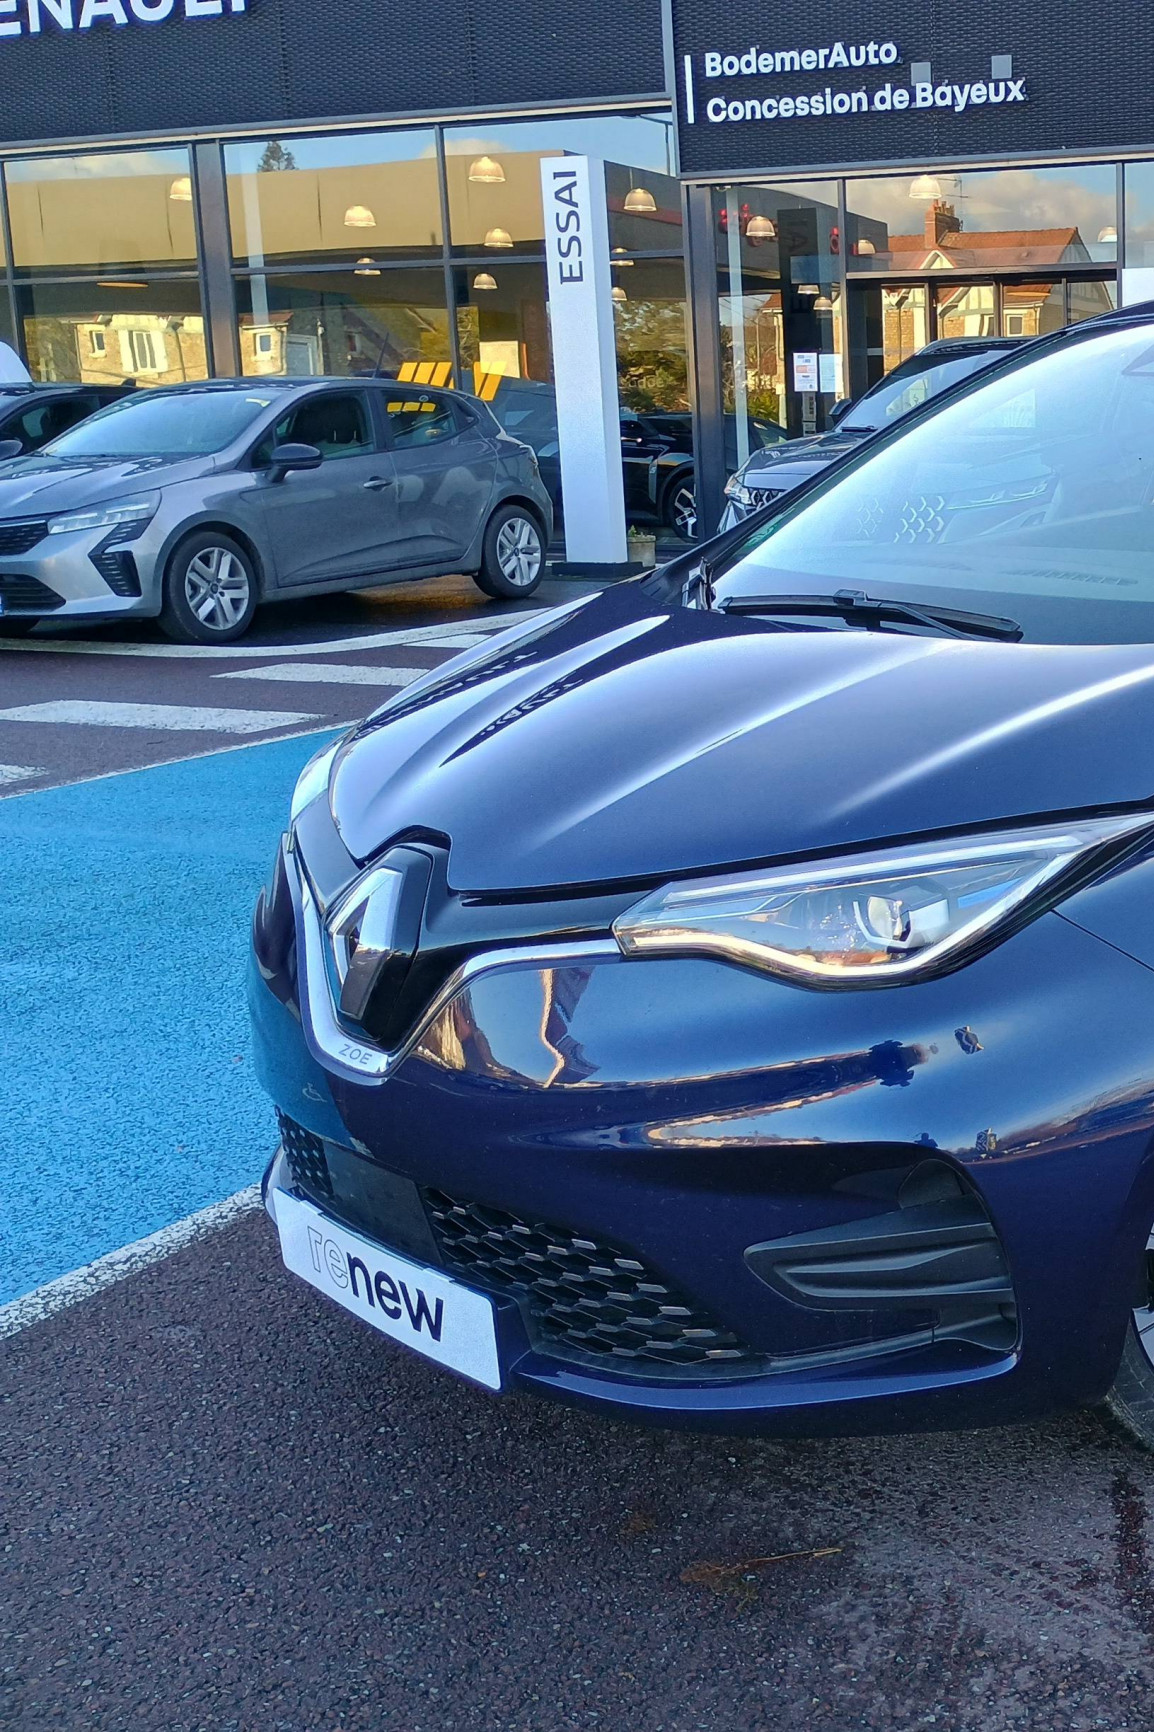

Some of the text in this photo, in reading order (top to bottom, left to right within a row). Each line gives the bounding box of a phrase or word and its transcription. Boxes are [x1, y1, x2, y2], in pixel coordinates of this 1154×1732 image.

[705, 41, 898, 77] BodemerAuto
[706, 80, 1025, 122] Concession de Bayeux
[553, 171, 584, 285] ESSAI
[338, 1043, 373, 1065] ZOE
[307, 1225, 444, 1343] renew
